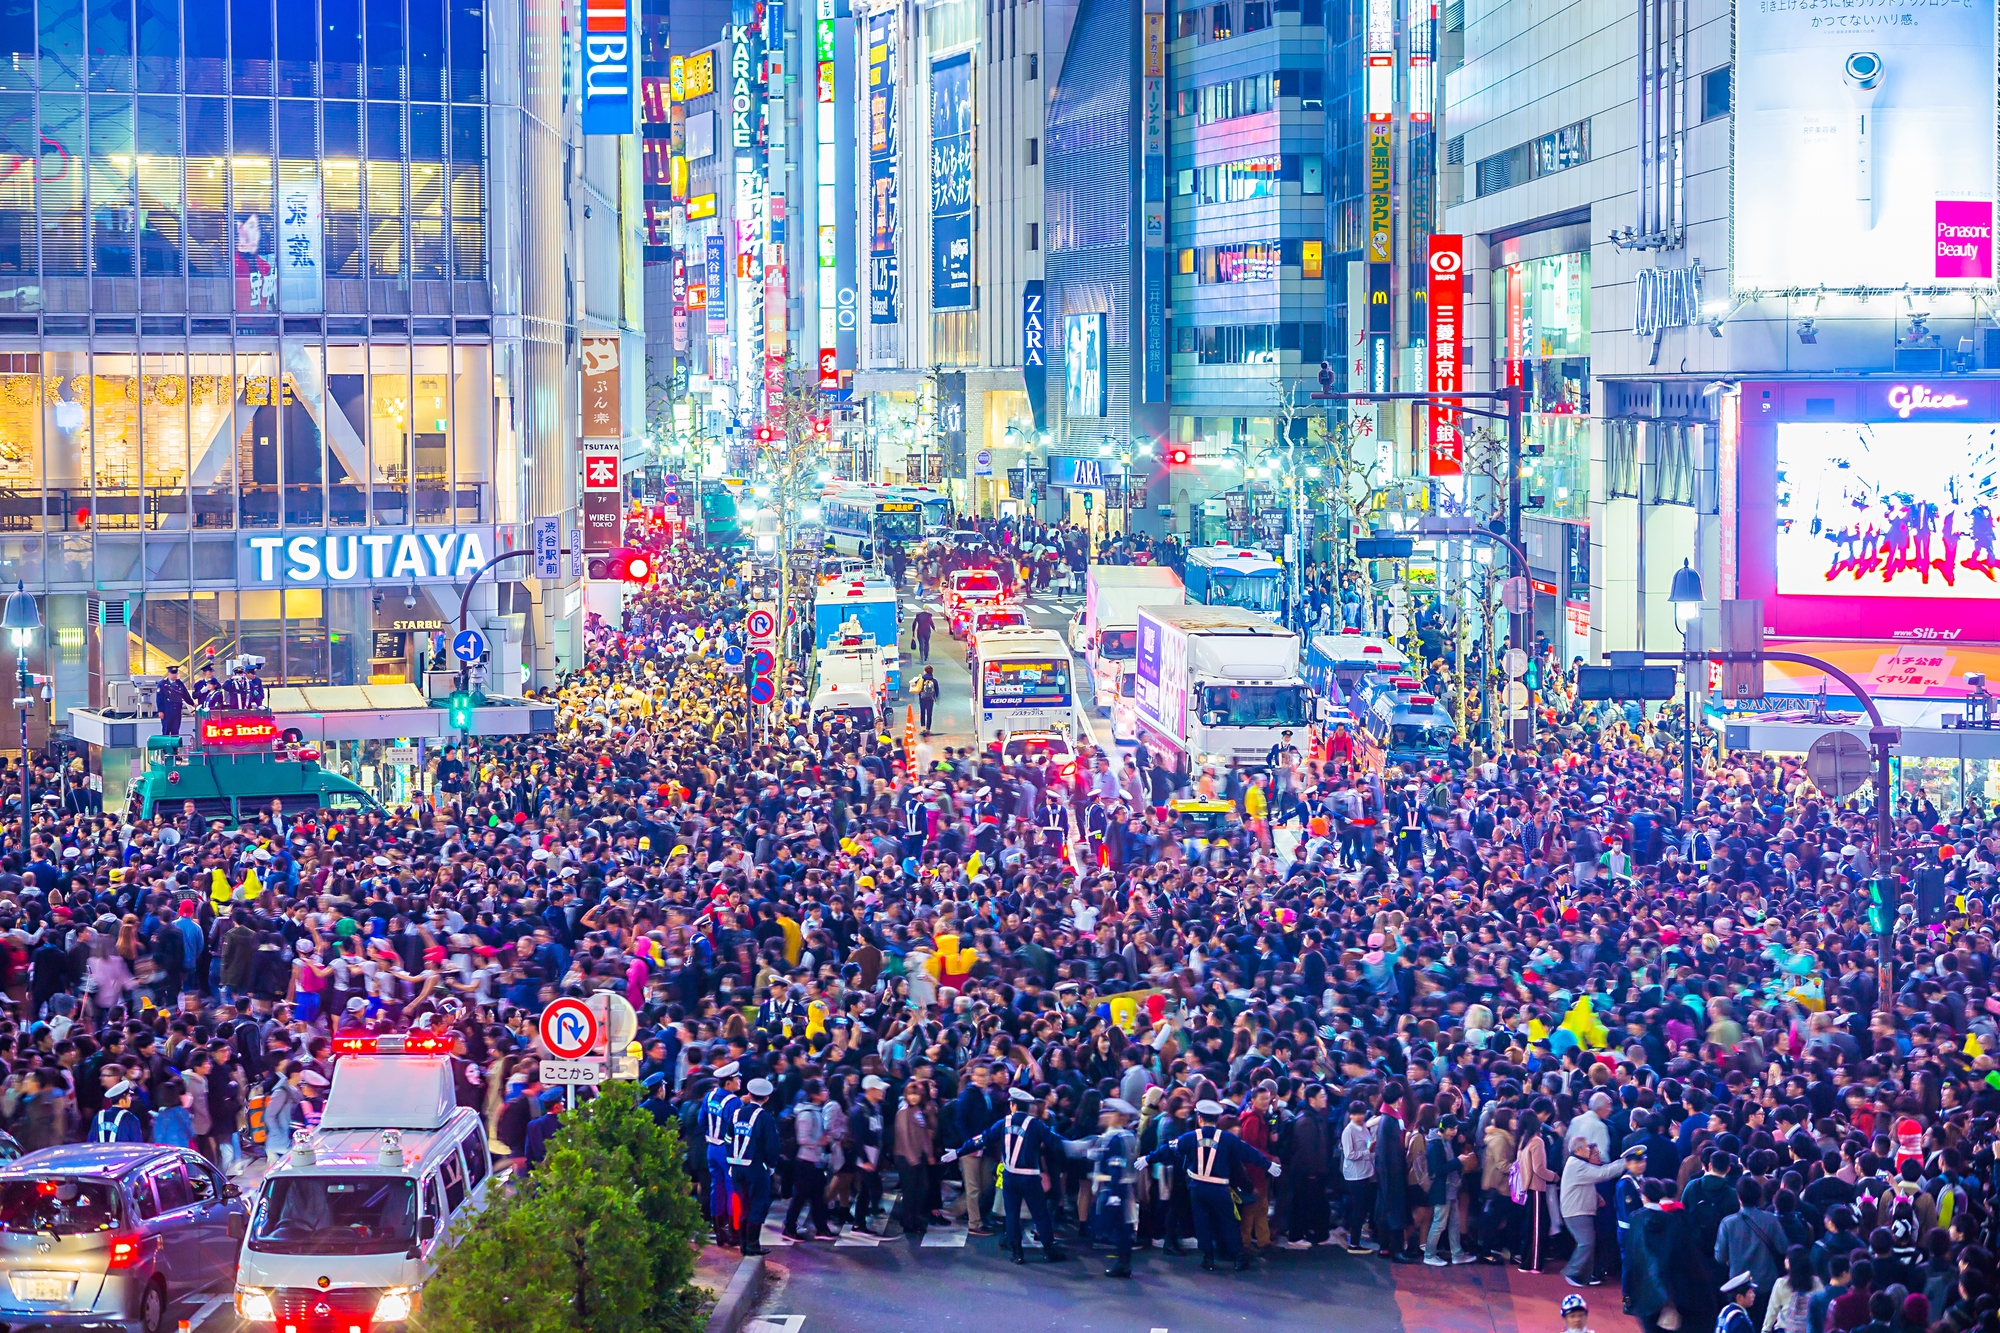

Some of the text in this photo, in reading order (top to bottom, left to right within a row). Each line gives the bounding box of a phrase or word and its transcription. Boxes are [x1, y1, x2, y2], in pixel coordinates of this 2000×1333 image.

[1811, 14, 1919, 28] かつてないハリ感。
[732, 26, 751, 147] KARAOKE
[1148, 81, 1160, 136] パーソナル
[1374, 126, 1387, 135] 4F
[1371, 136, 1389, 231] 八重洲コンタクト
[1938, 222, 1991, 238] Panasonic
[1938, 241, 1979, 261] Beauty
[708, 247, 720, 299] 渋谷整形
[872, 258, 888, 292] 10.25
[1025, 295, 1043, 366] ZARA
[1149, 280, 1160, 373] 三井住友信託銀行
[1889, 384, 1968, 418] Glico
[590, 460, 614, 484] 本
[1074, 460, 1101, 486] ZARA
[250, 533, 489, 581] TSUTAYA
[545, 521, 557, 574] 渋谷駅前
[1887, 657, 1943, 667] ハチ公前
[1875, 675, 1939, 685] くすり屋さん
[545, 1067, 594, 1081] ここから
